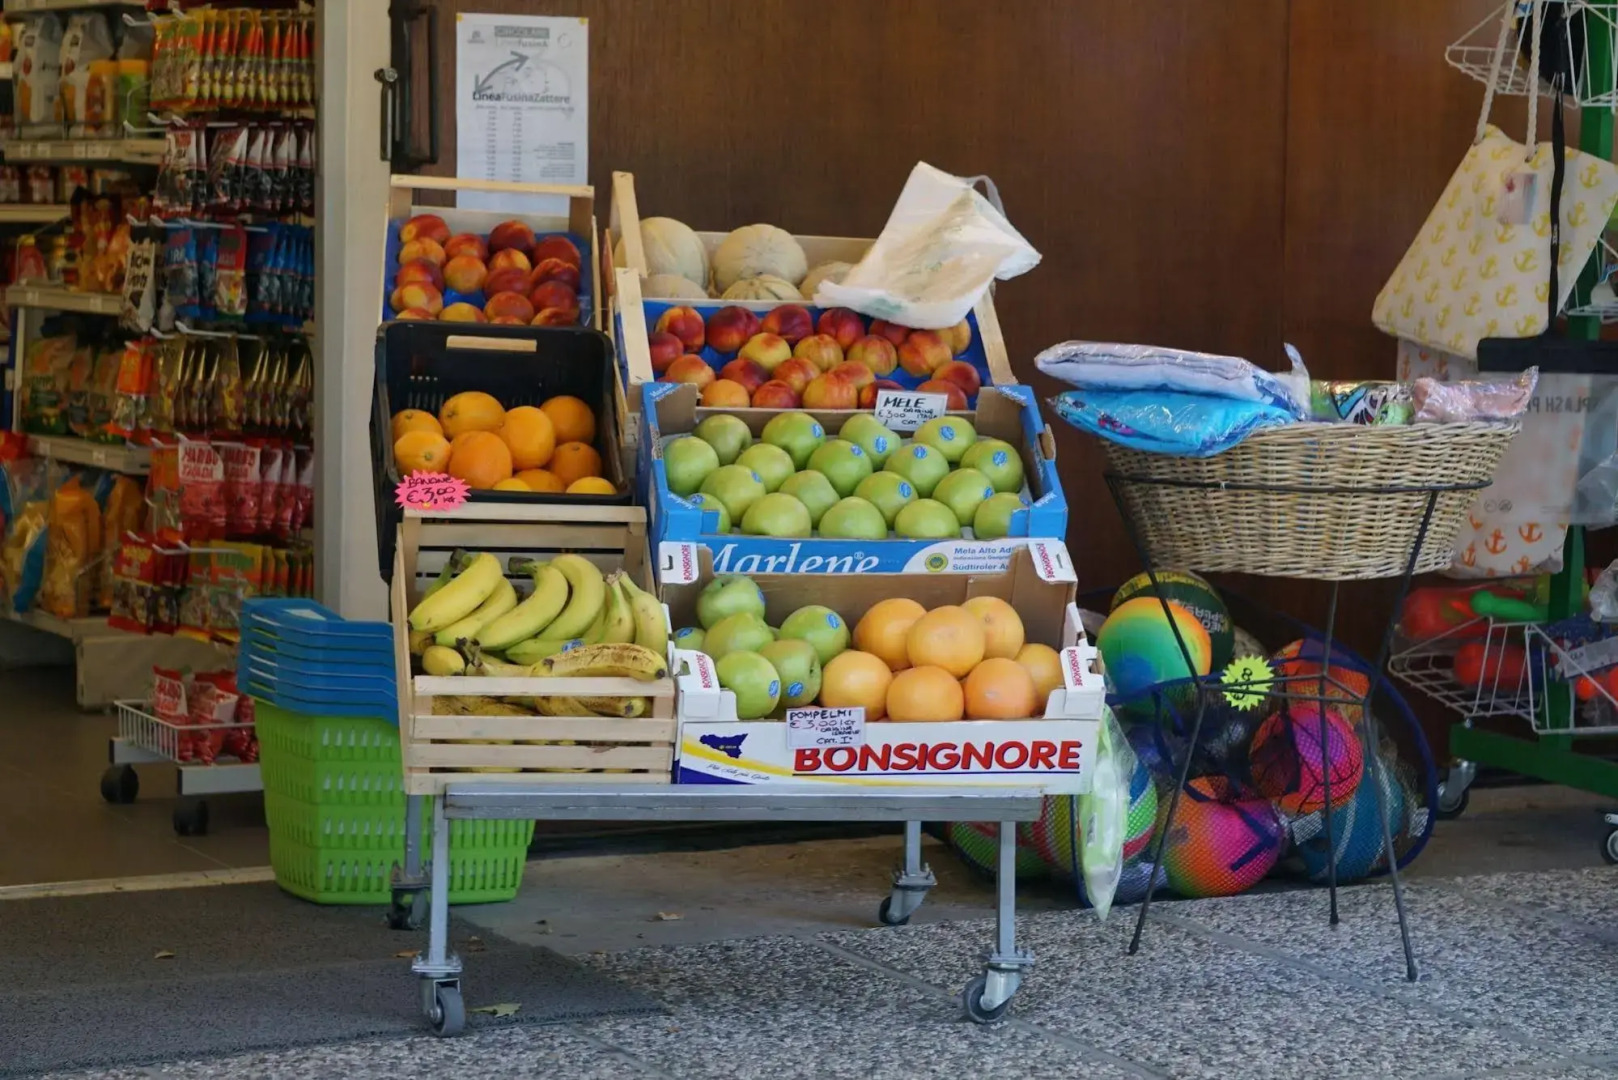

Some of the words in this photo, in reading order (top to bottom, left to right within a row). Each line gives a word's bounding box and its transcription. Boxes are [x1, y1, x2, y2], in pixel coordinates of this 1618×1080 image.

[883, 396, 926, 408] MELE
[407, 477, 453, 488] BANANE
[407, 490, 422, 503] €
[953, 563, 998, 571] Südtiroler
[1067, 649, 1083, 686] BONSIGNORE
[790, 710, 852, 720] POMPELMI
[794, 740, 1082, 773] BONSIGNORE
